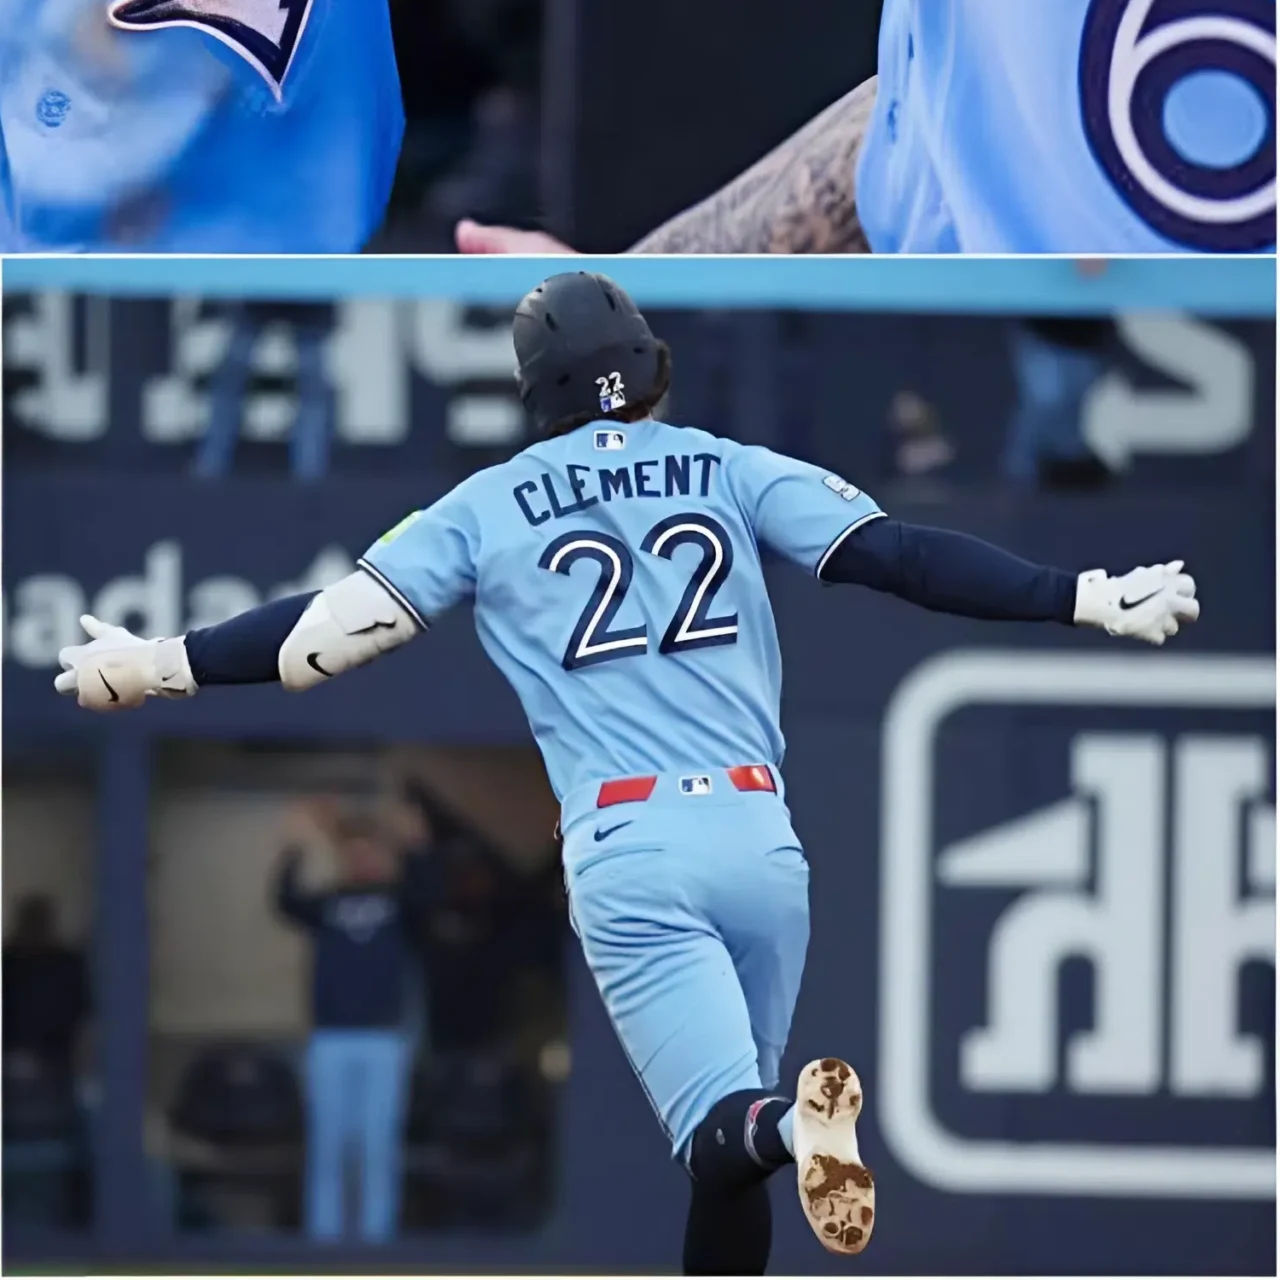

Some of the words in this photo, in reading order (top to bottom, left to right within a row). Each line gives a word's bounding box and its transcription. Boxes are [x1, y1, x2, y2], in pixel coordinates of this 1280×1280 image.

[595, 371, 625, 397] 22
[513, 453, 721, 526] CLEMENT
[537, 512, 739, 672] 22
